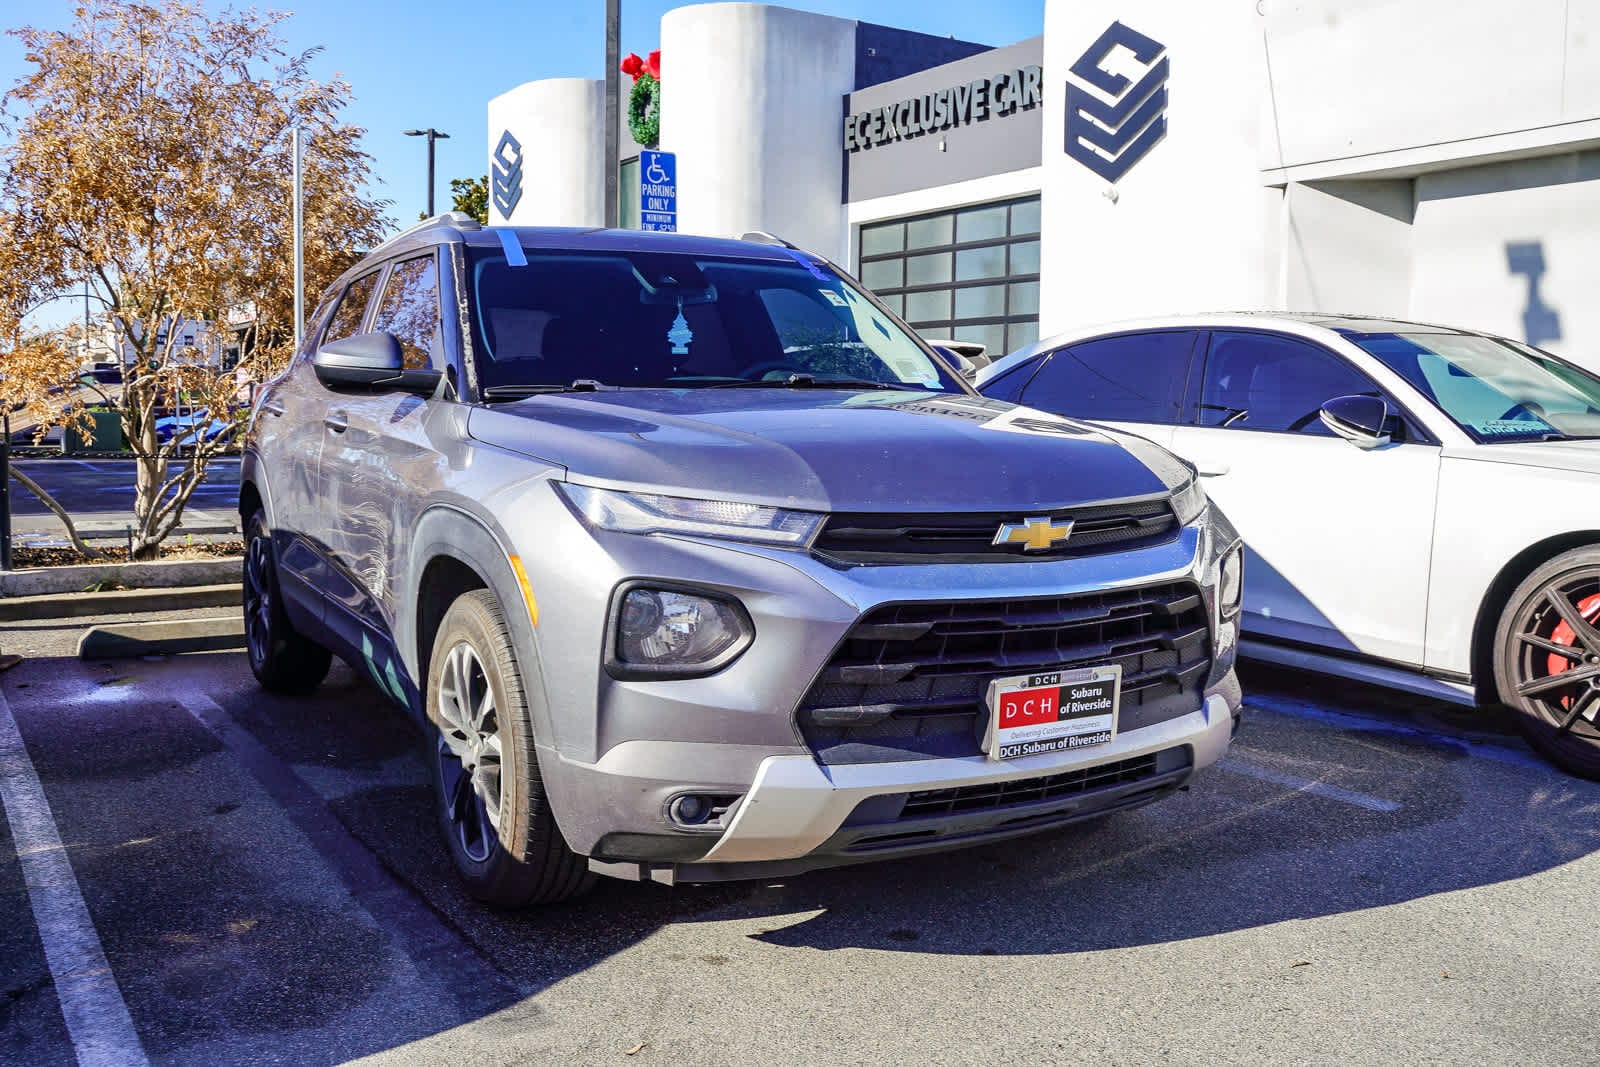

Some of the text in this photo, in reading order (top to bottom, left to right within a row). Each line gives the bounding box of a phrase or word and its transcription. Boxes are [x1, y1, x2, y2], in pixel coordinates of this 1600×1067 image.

[844, 112, 869, 151] EC
[867, 79, 988, 145] EXCLUSIVE
[642, 183, 675, 198] PARKING
[648, 197, 669, 211] ONLY
[646, 213, 672, 223] MINIMUM
[1035, 675, 1058, 685] DCH
[1071, 687, 1102, 699] Subaru
[1006, 697, 1052, 719] DCH
[1060, 698, 1112, 714] of Riverside
[1000, 732, 1111, 758] DCH Subaru of Riverside
